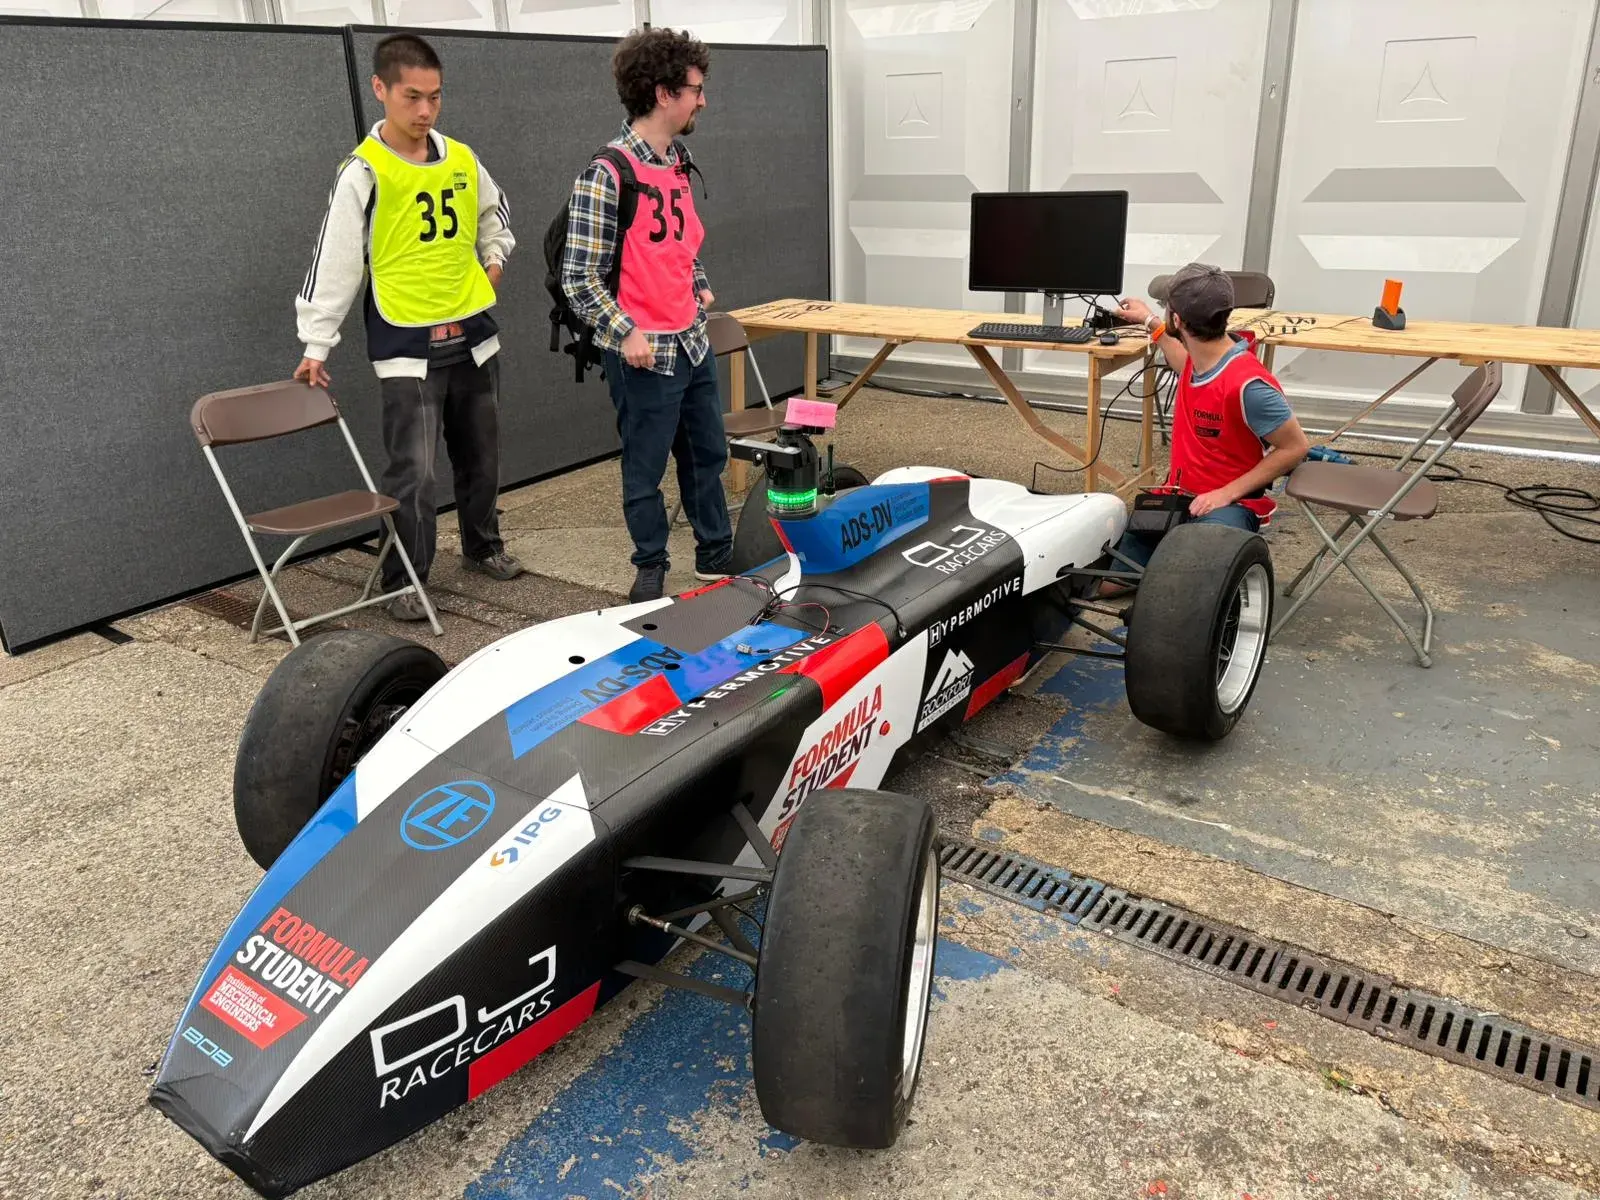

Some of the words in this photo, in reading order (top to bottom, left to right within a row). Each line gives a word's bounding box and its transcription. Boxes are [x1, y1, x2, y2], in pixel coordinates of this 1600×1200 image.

[415, 187, 459, 243] 35
[647, 185, 686, 243] 35
[841, 499, 893, 554] ADS-DV
[935, 530, 1007, 575] RACECARS
[929, 576, 1021, 648] HYPERMOTIVE
[581, 646, 684, 705] ADS-DV
[639, 634, 833, 737] HYPERMOTIVE
[921, 670, 975, 720] ROCKFORT
[787, 683, 883, 791] FORMULA
[778, 717, 877, 821] STUDENT
[404, 783, 492, 846] ZF
[513, 806, 562, 845] IPG
[236, 934, 344, 1015] STUDENT
[259, 907, 370, 989] FORMULA
[209, 991, 262, 1033] ENGINEERS
[217, 980, 278, 1029] MECHANICAL
[226, 973, 260, 1000] Institution
[379, 989, 557, 1109] RACECARS
